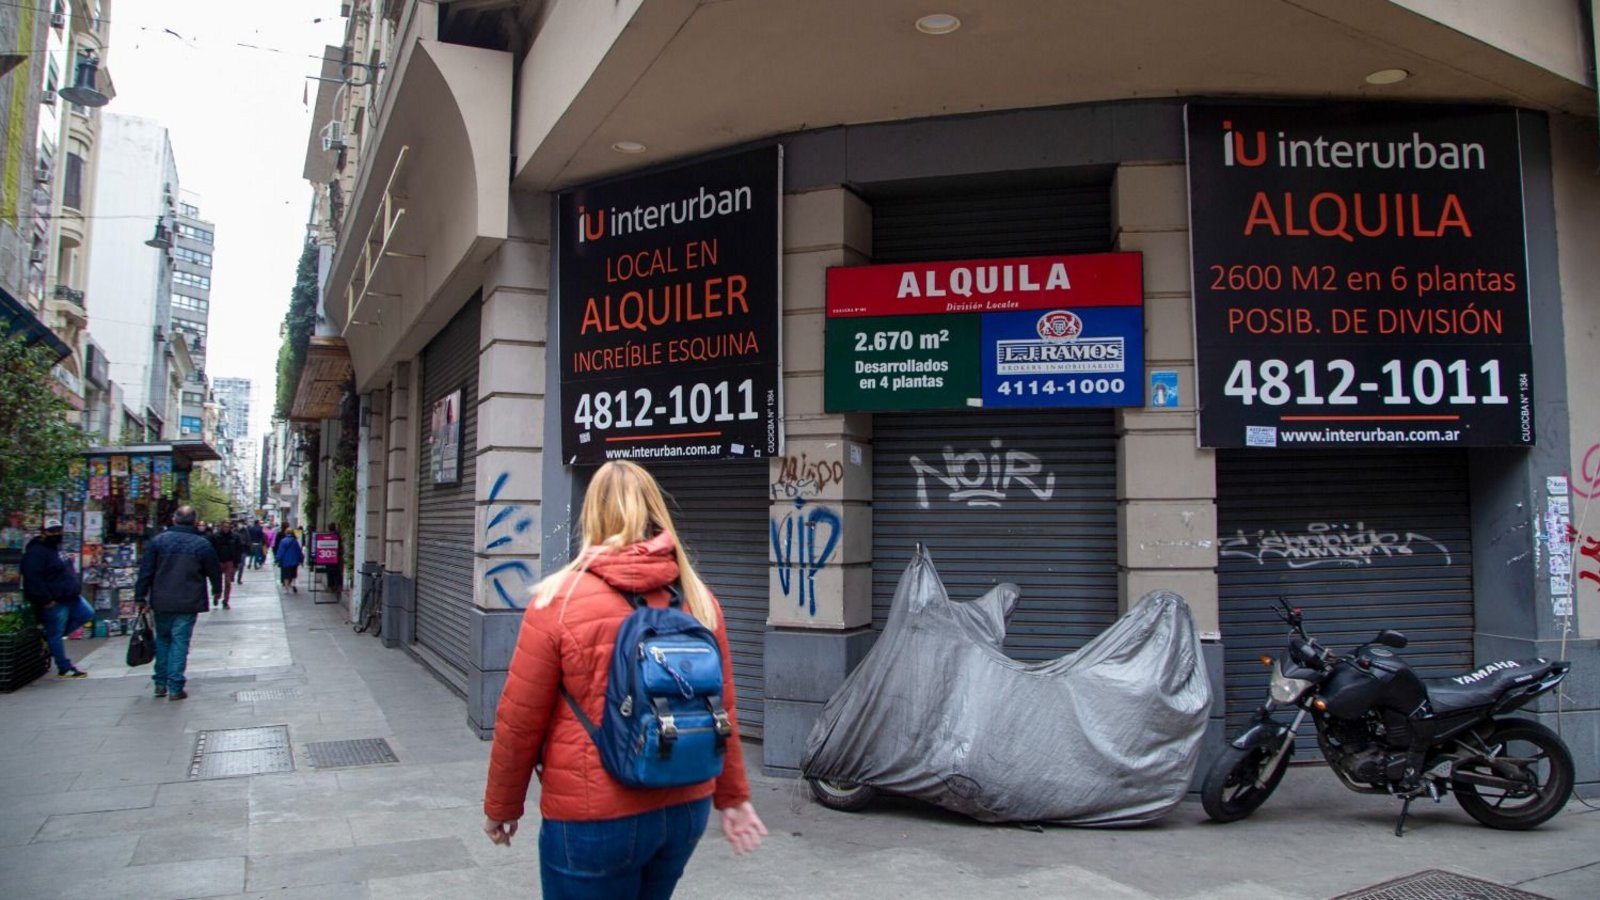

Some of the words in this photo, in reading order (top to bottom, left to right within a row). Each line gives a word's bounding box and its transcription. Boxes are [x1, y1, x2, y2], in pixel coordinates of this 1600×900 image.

[1278, 132, 1485, 169] interurban
[611, 186, 751, 237] interurban
[1244, 191, 1472, 242] ALQUILA
[607, 248, 678, 283] LOCAL
[686, 239, 718, 268] EN
[896, 263, 1071, 298] ALQUILA
[1210, 265, 1282, 291] 2600
[1291, 265, 1337, 291] M2
[1347, 270, 1381, 291] en
[1391, 265, 1408, 291] 6
[1417, 265, 1516, 297] plantas
[580, 275, 749, 335] ALQUILER
[986, 300, 1019, 309] Locales
[1228, 308, 1321, 334] POSIB.
[1332, 308, 1369, 334] DE
[1379, 303, 1503, 334] DIVISIÓN
[574, 340, 662, 373] INCREÍBLE
[668, 331, 759, 363] ESQUINA
[855, 330, 913, 351] 2.670
[855, 358, 949, 374] Desarrollados
[860, 378, 876, 389] en
[880, 375, 889, 389] 4
[892, 374, 944, 391] plantas
[1224, 359, 1509, 406] 4812-1011
[997, 378, 1125, 395] 4114-1000
[574, 379, 759, 431] 4812-1011
[1281, 428, 1460, 443] www.interurban.com.ar
[1521, 404, 1531, 442] CUCICBA
[606, 443, 722, 459] www.interurban.com.ar
[1452, 660, 1521, 685] YAMAHA
